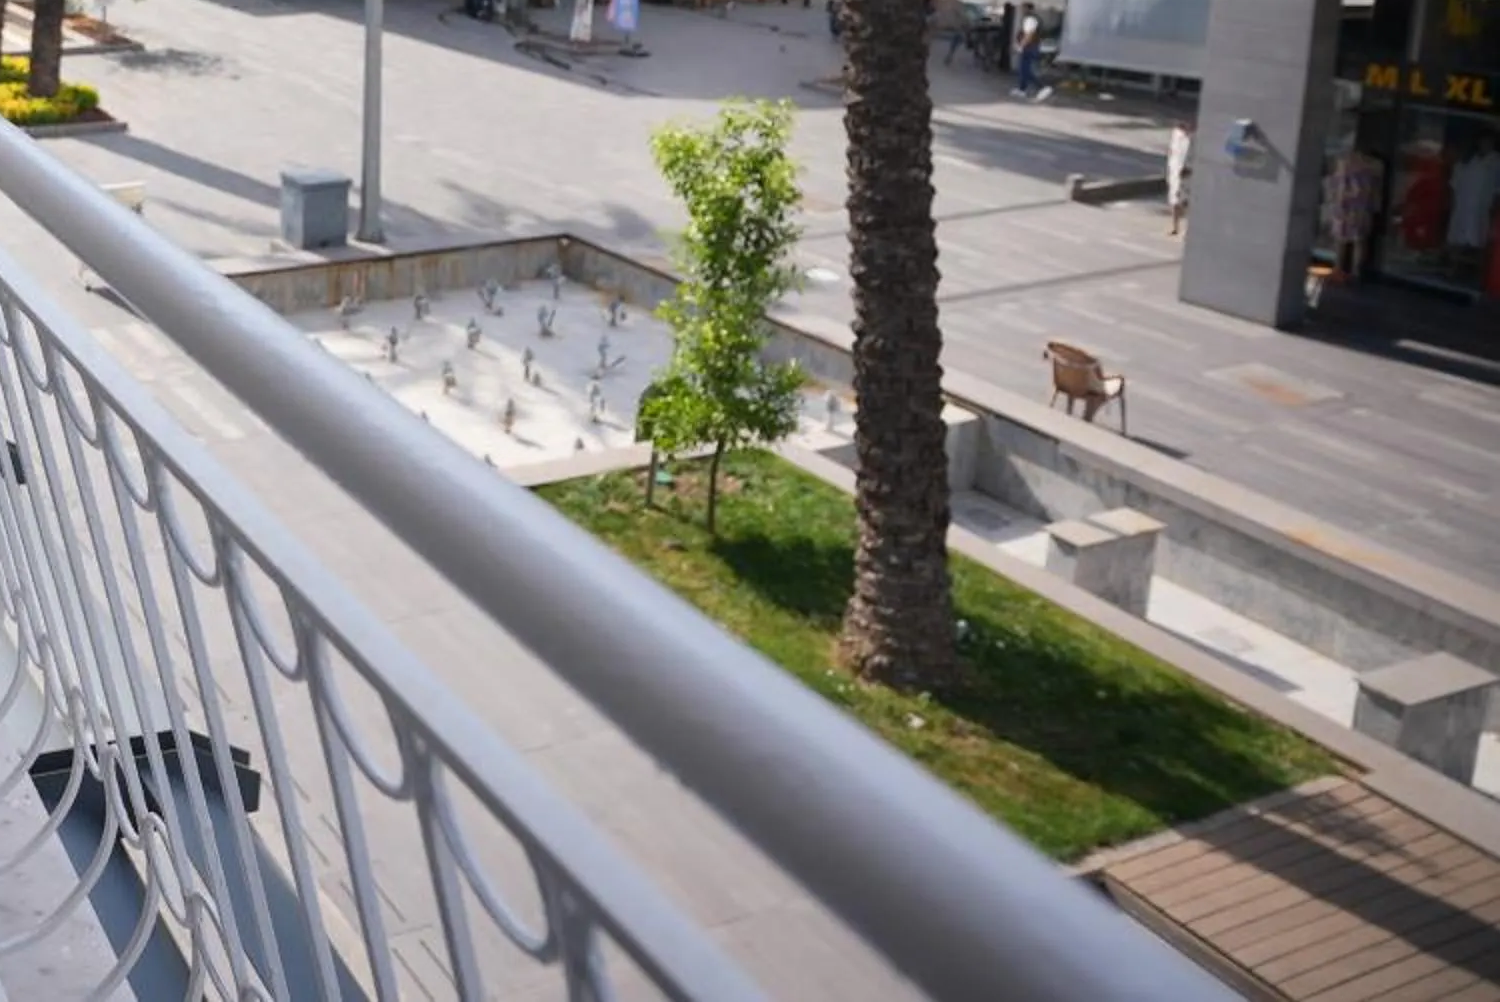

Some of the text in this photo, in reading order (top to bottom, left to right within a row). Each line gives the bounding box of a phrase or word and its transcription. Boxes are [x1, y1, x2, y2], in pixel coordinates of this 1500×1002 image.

[1366, 62, 1493, 105] M L XL
